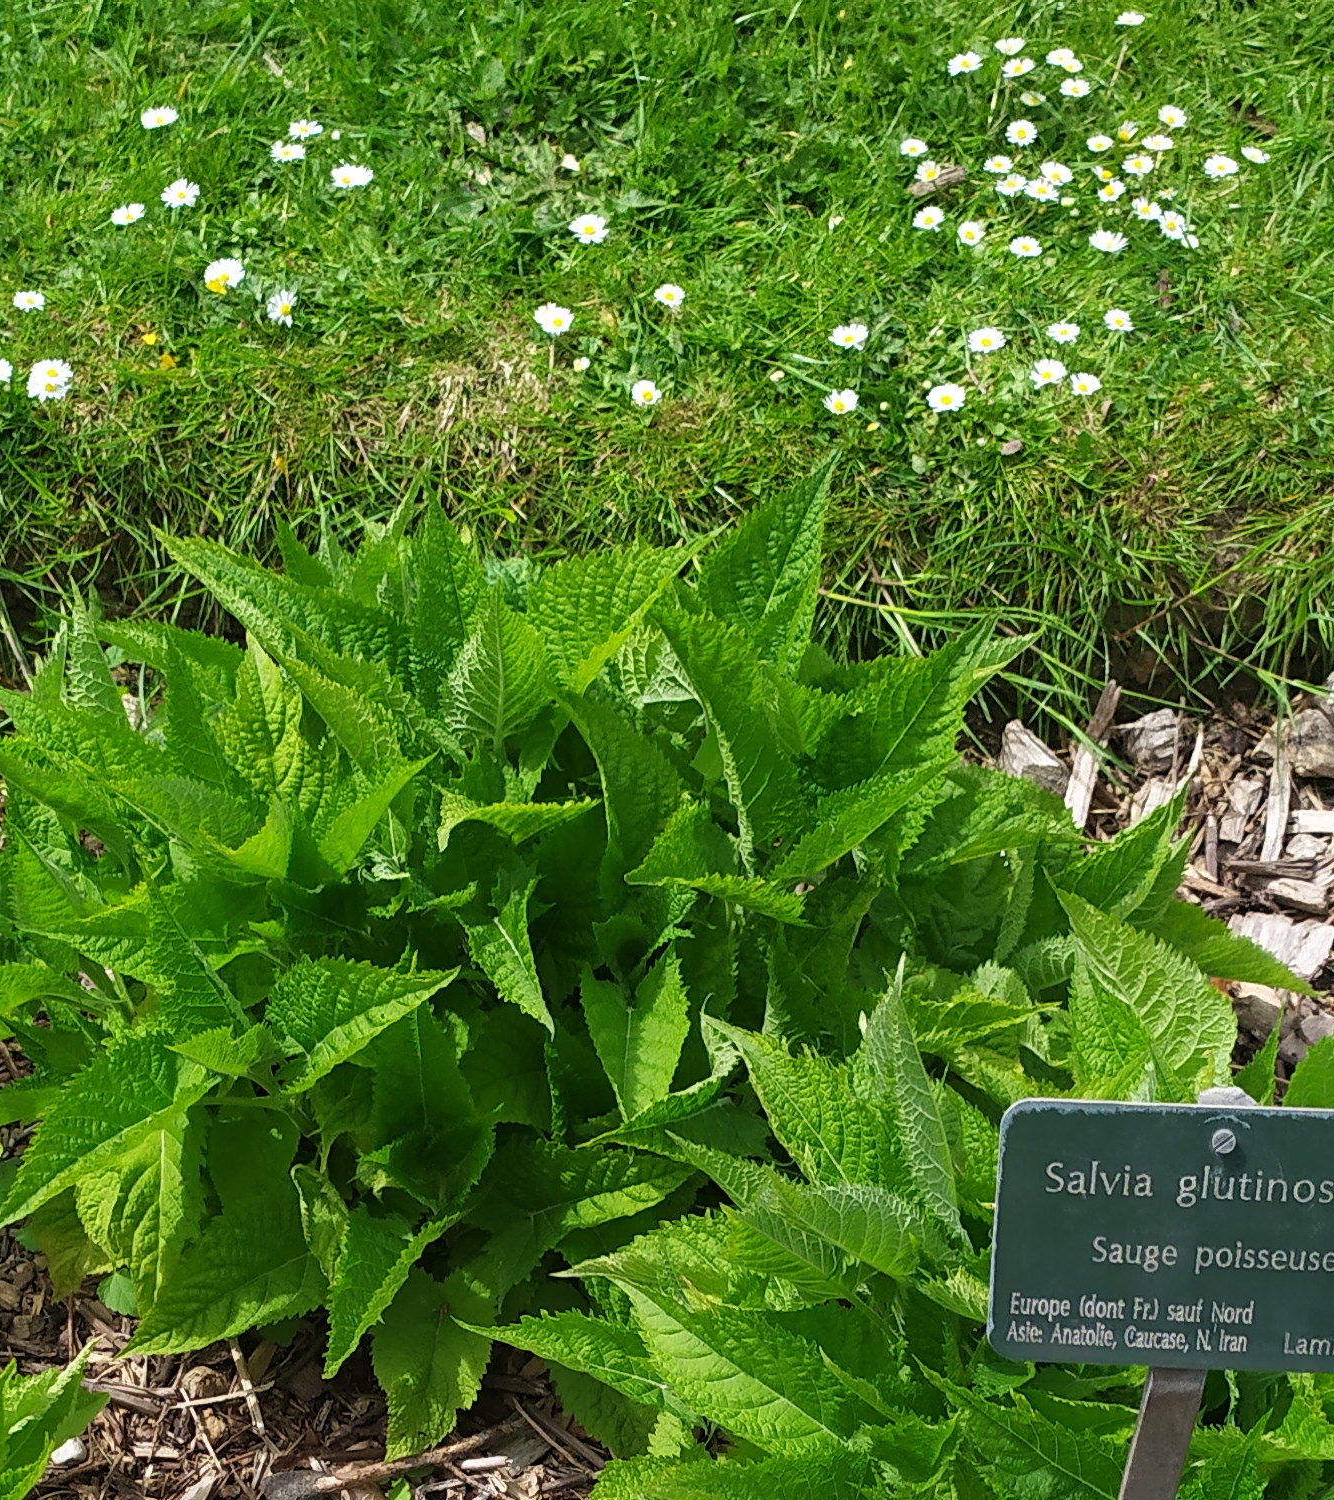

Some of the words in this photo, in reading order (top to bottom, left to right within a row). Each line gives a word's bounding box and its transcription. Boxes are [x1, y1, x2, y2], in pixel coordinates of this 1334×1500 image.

[1046, 1161, 1153, 1198] Salvia
[1092, 1236, 1178, 1272] Sauge
[1010, 1292, 1070, 1321] Europe
[1079, 1296, 1125, 1320] (dont
[1133, 1299, 1159, 1320] Fr.)
[1167, 1299, 1205, 1321] sauf
[1212, 1301, 1255, 1325] Nord
[1006, 1321, 1043, 1343] Asie:
[1051, 1323, 1117, 1350] Anatolie,
[1124, 1327, 1190, 1352] Caucase,
[1219, 1330, 1248, 1353] Iran
